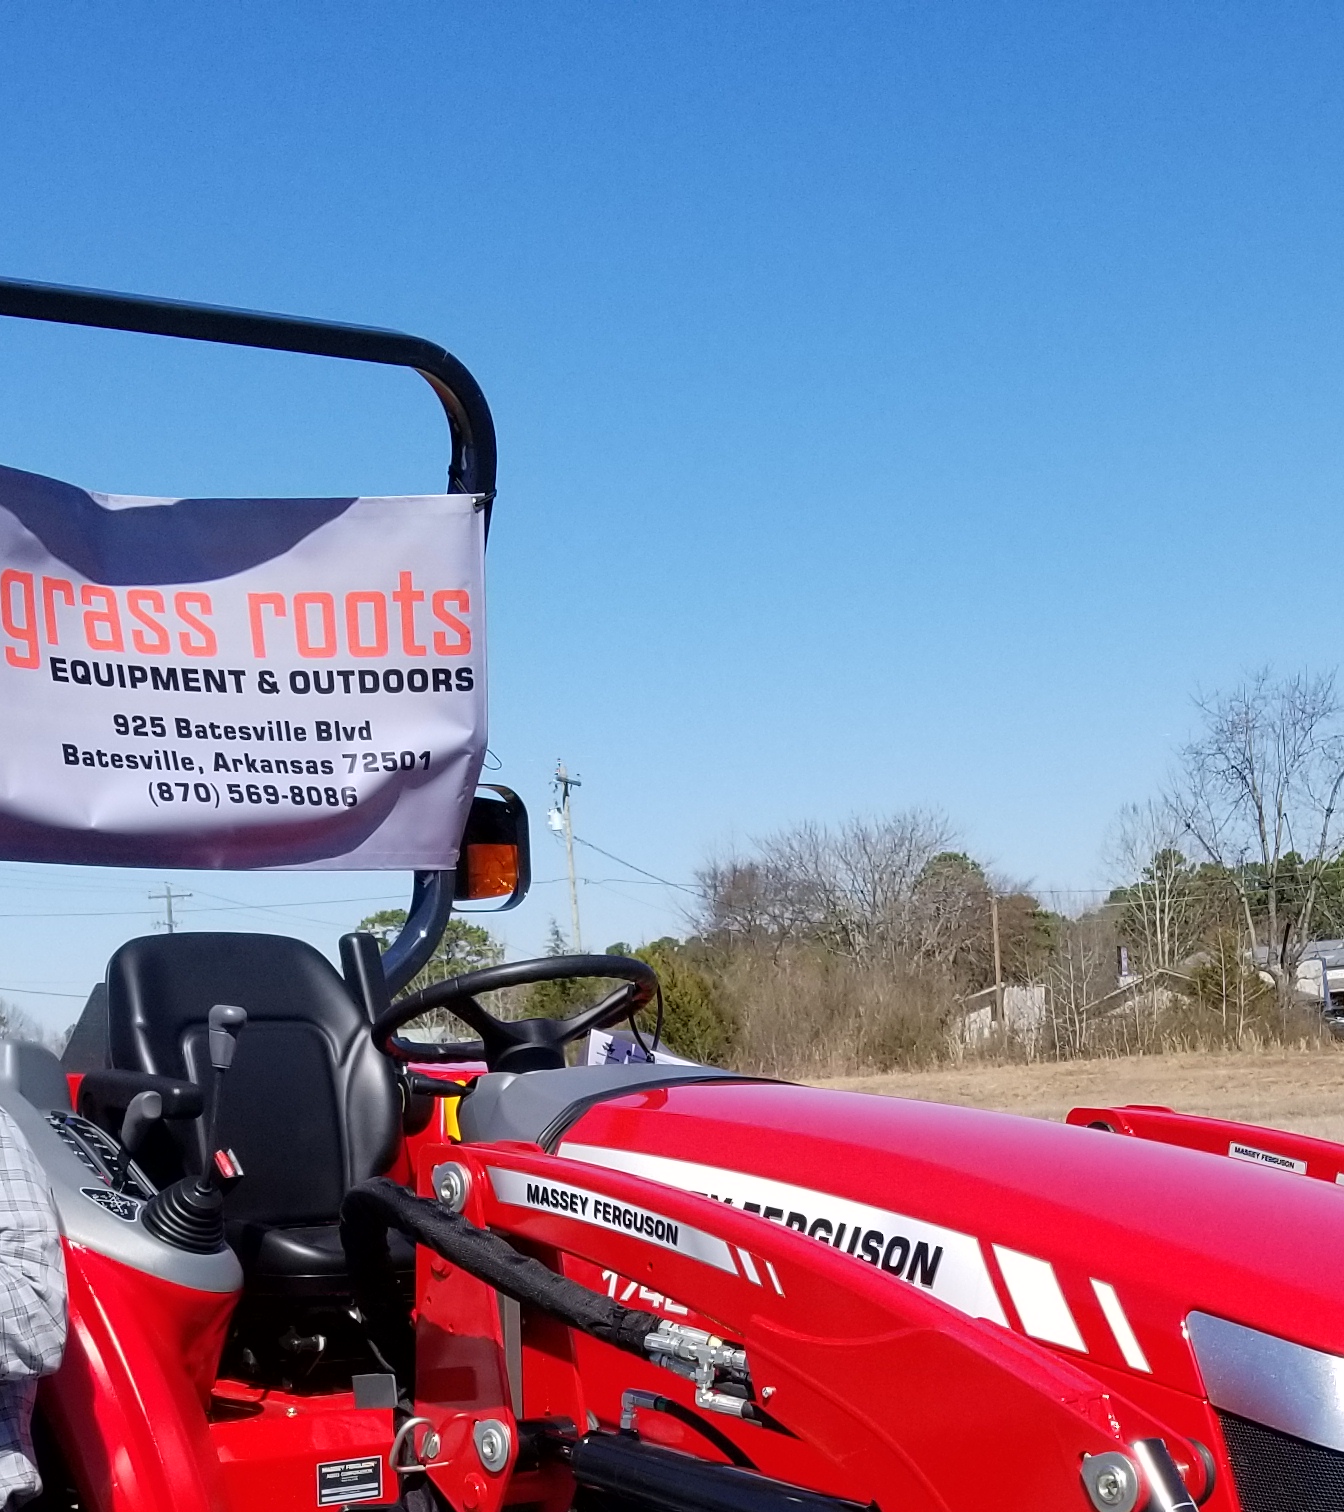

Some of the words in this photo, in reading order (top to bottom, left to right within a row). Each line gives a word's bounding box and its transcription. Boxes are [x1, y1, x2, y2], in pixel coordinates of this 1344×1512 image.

[0, 569, 218, 670] grass
[249, 571, 471, 658] roots
[50, 657, 246, 694] EQUIPMENT
[257, 669, 280, 695] &
[294, 667, 475, 694] OUTDOORS
[113, 714, 167, 739] 925
[175, 718, 307, 743] Batesville
[316, 718, 373, 743] Blvd
[62, 743, 206, 775] Batesville,
[213, 750, 334, 776] Arkansas
[341, 750, 433, 775] 72501
[148, 780, 221, 810] (870)
[228, 783, 358, 808] 569-8086
[1234, 1146, 1261, 1160] MASSEY
[1261, 1153, 1295, 1169] FERGUSON
[526, 1182, 589, 1216] MASSEY
[593, 1199, 679, 1247] FERGUSON
